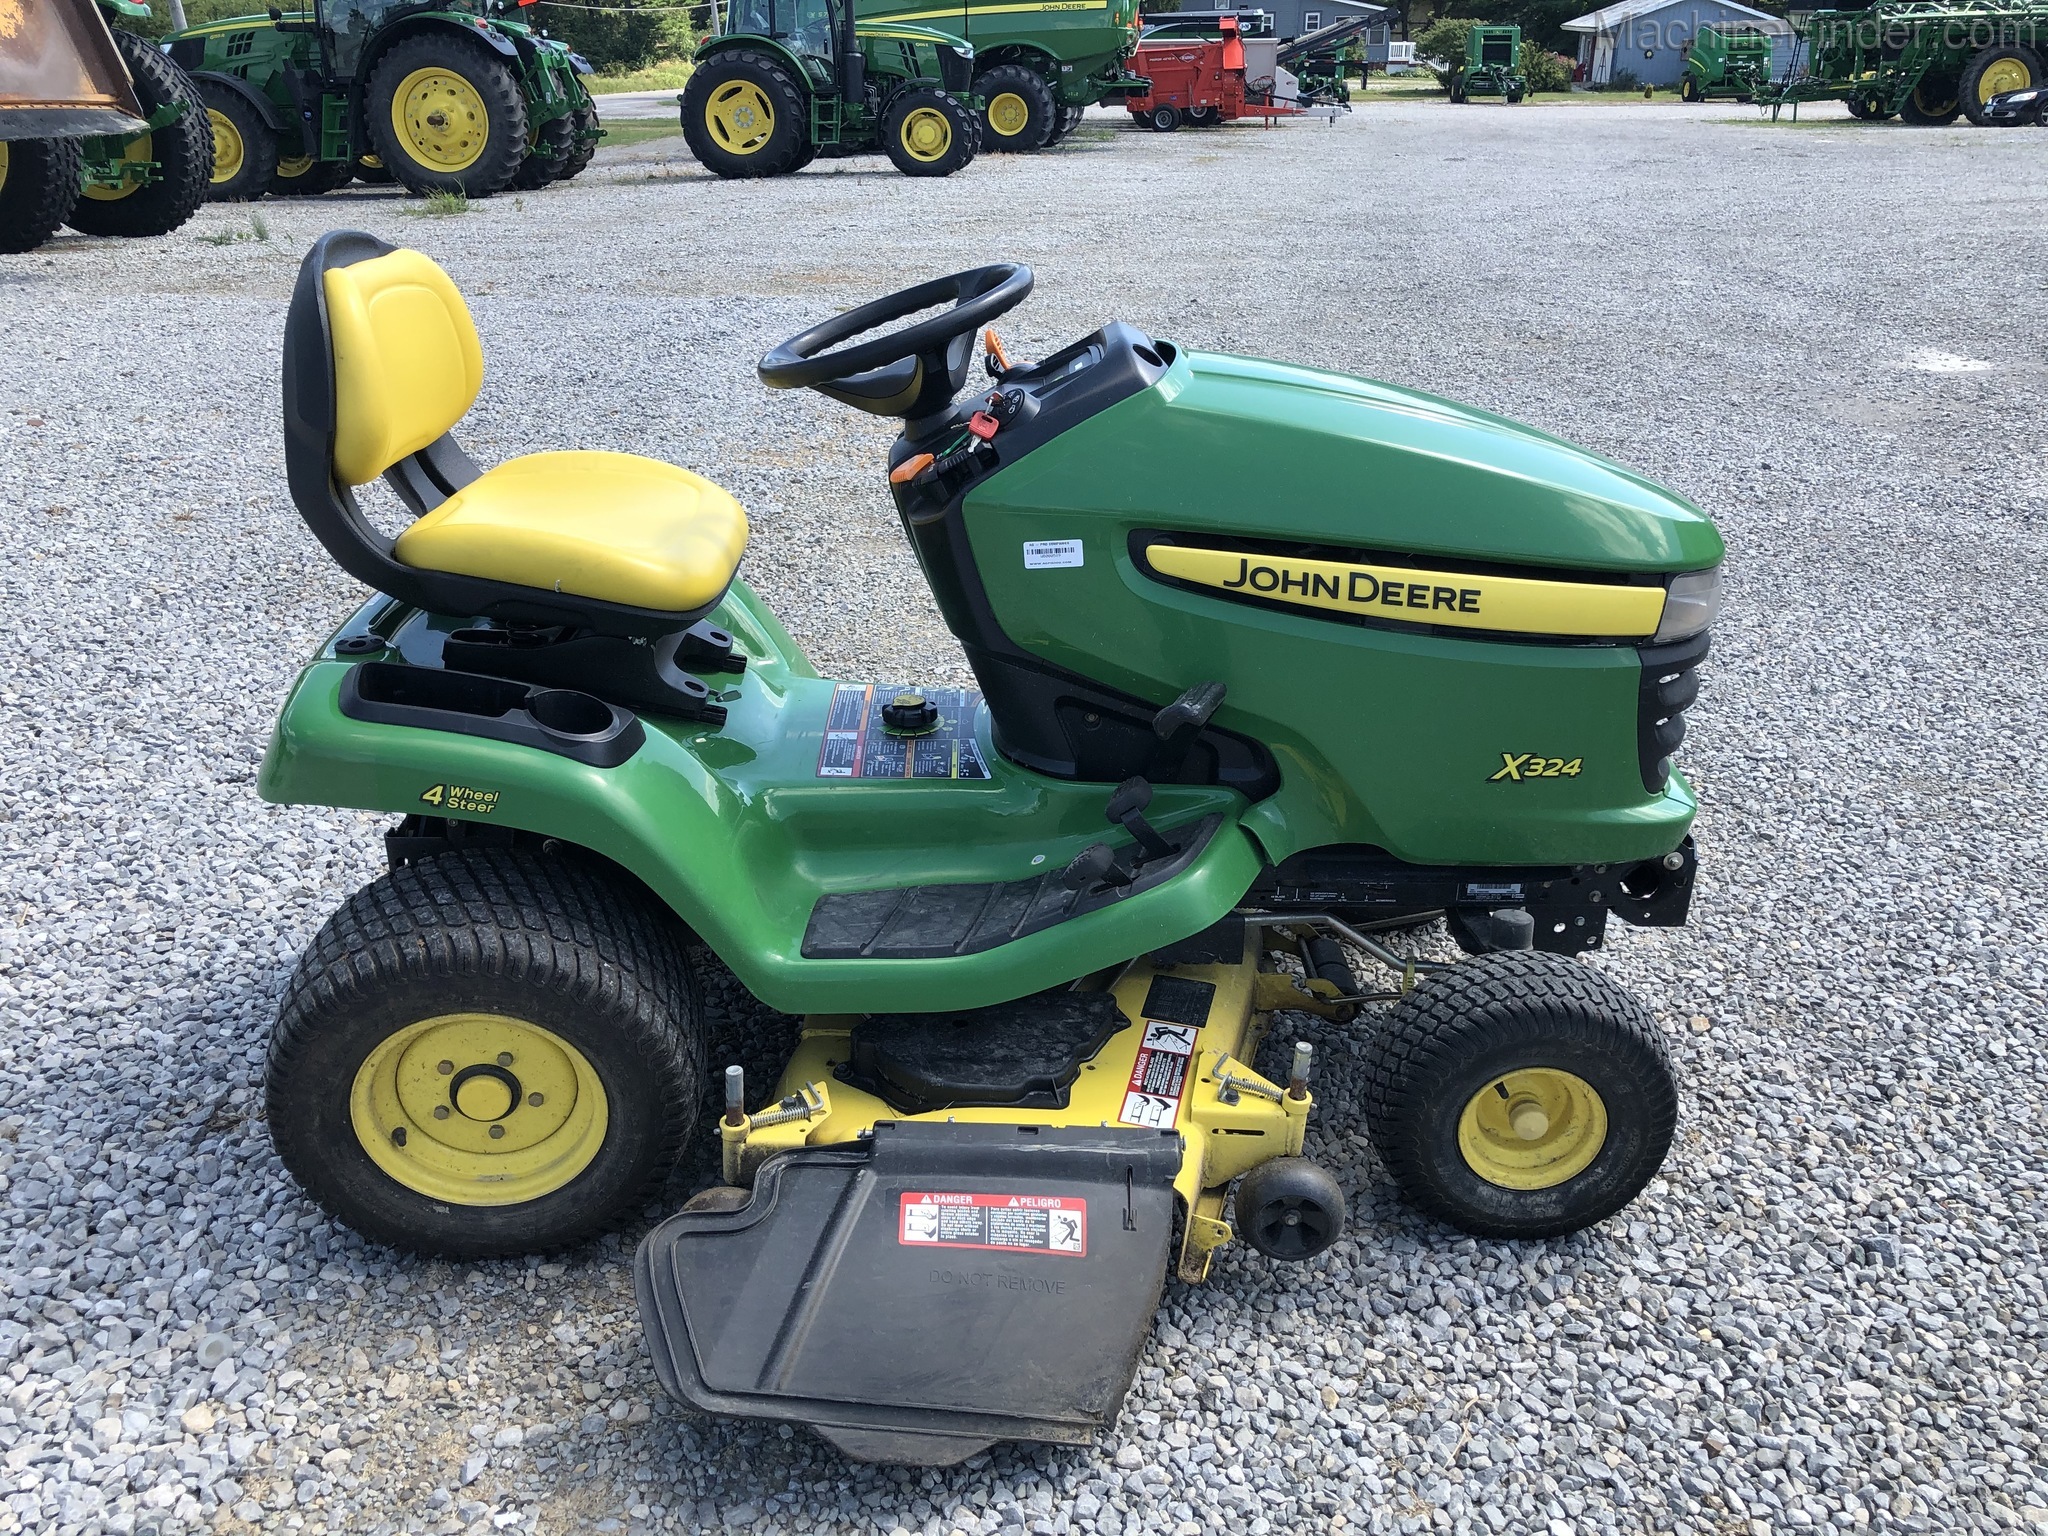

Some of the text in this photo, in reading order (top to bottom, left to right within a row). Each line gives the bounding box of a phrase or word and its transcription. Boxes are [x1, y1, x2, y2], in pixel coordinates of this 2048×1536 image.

[1223, 558, 1482, 614] JOHN DEERE
[1486, 752, 1583, 781] X324
[420, 783, 500, 806] 4 Wheel
[447, 797, 495, 813] Steer
[1134, 1053, 1148, 1079] DANGER
[933, 1194, 973, 1204] DANGER
[1020, 1197, 1062, 1208] PELIGRO
[930, 1269, 1066, 1295] DO NOT REMOVE
